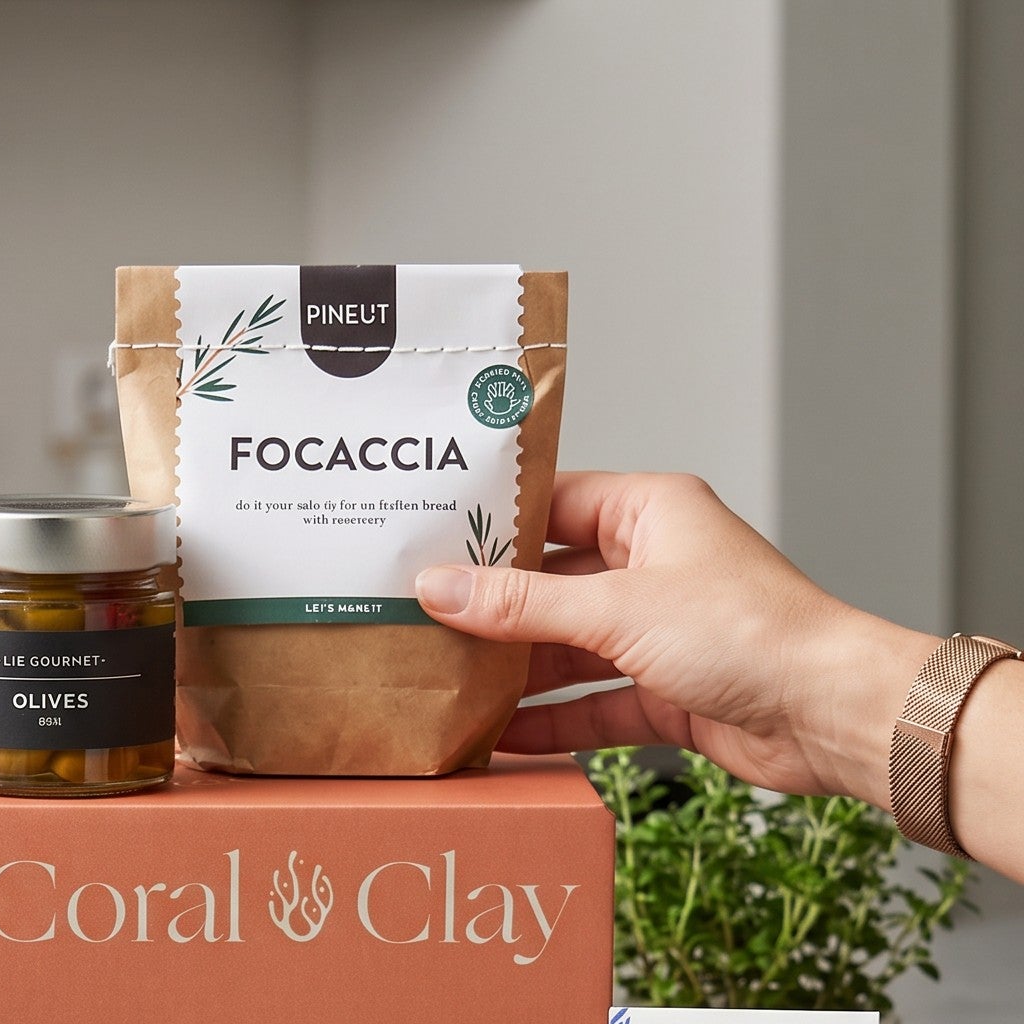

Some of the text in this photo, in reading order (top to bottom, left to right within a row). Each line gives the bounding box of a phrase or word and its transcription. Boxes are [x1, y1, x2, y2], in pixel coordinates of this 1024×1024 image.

[306, 303, 389, 325] PINEUT
[230, 436, 469, 471] FOCACCIA
[235, 500, 251, 511] do
[254, 500, 262, 511] it
[265, 502, 293, 513] your
[339, 500, 357, 511] for
[422, 500, 457, 511] bread
[302, 514, 329, 525] with
[3, 655, 100, 668] LIE GOURNET
[12, 693, 89, 709] OLIVES
[357, 849, 581, 966] Clay
